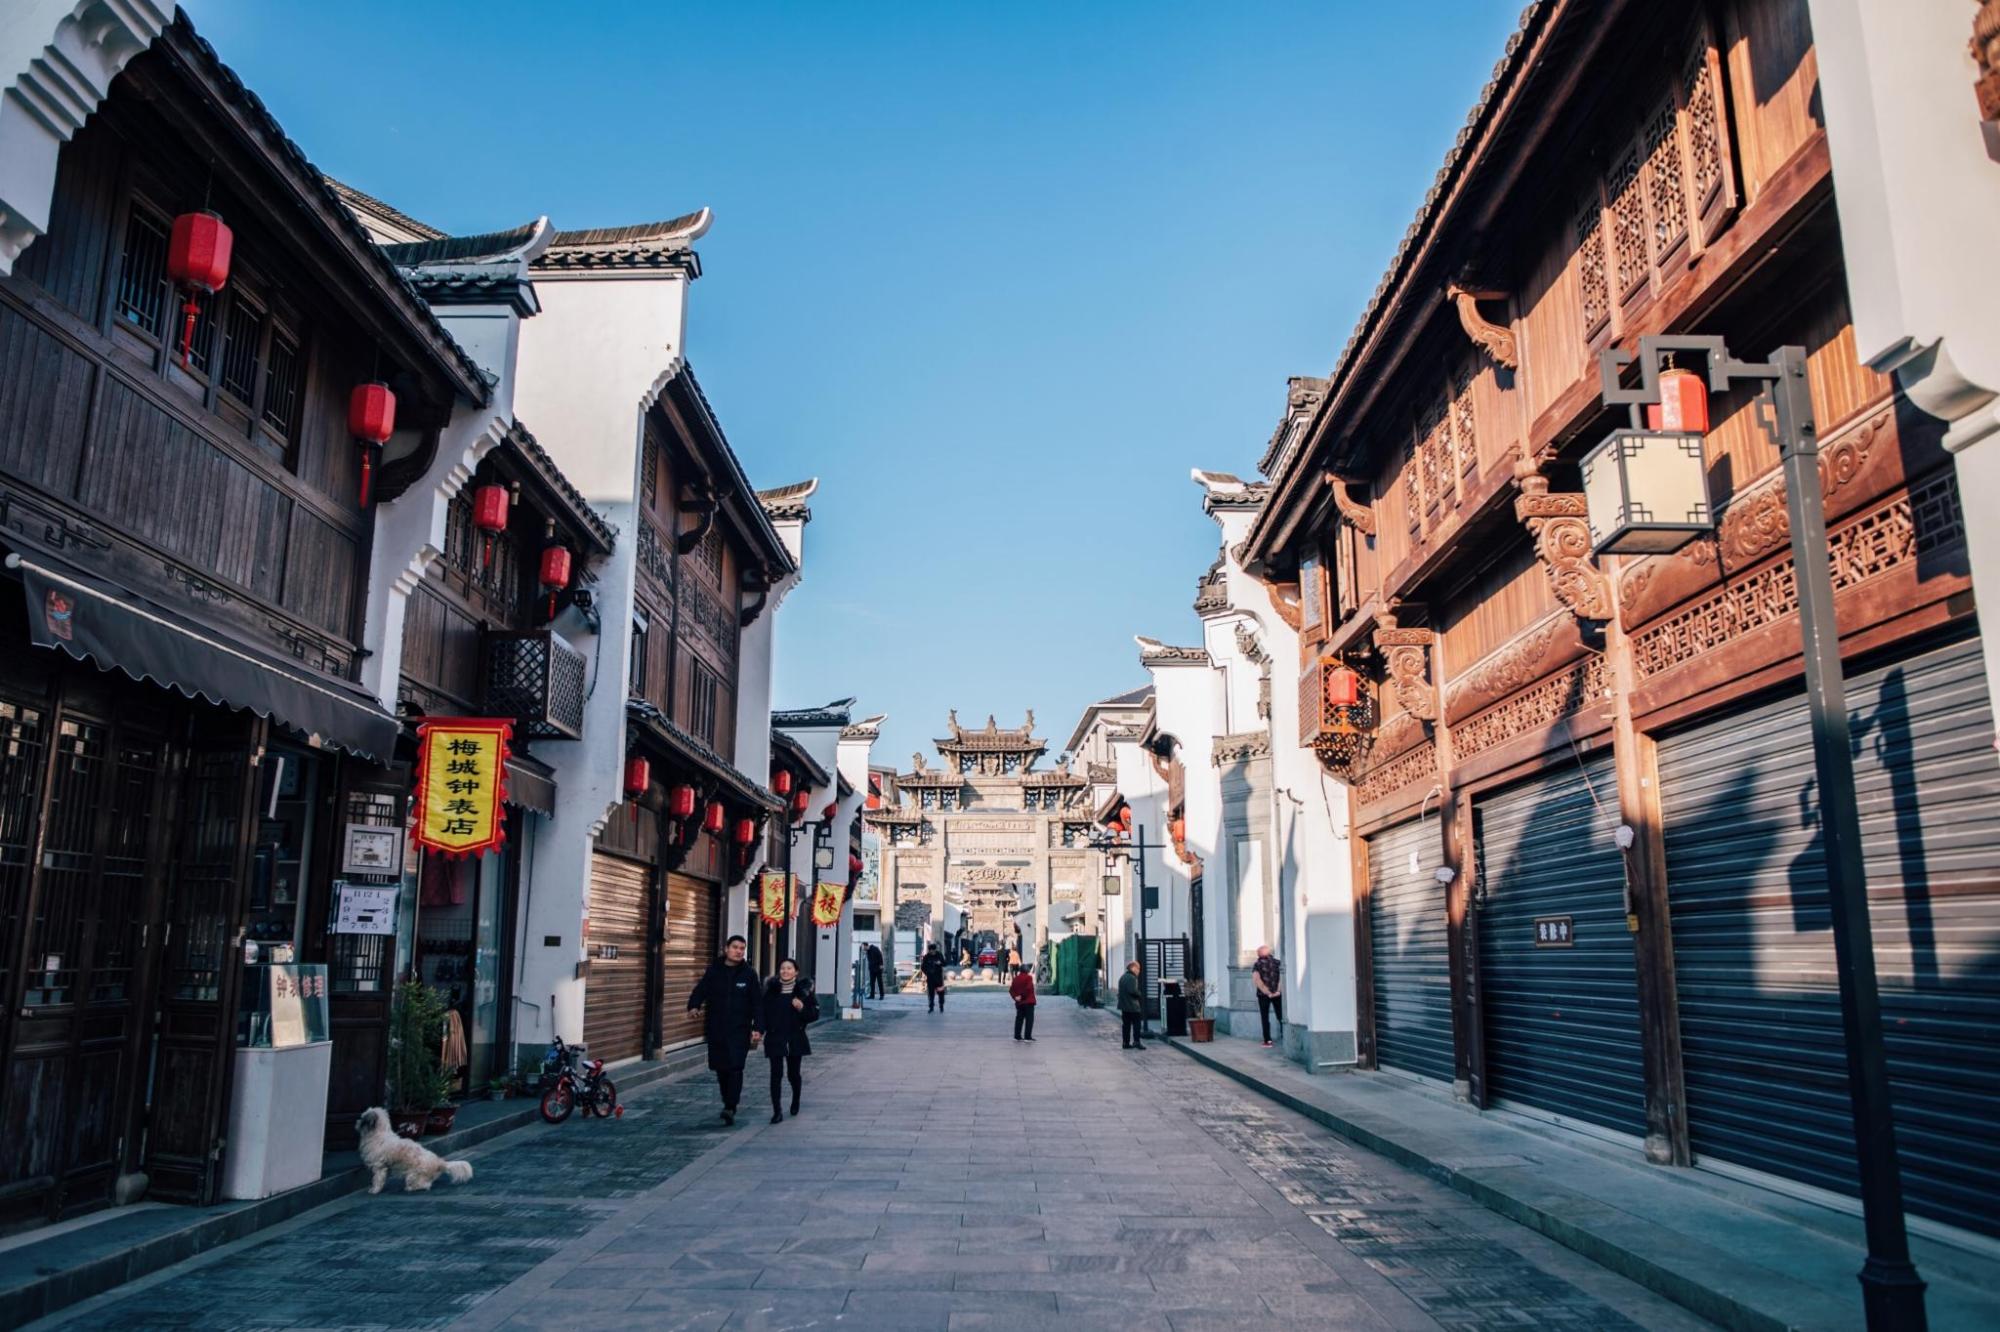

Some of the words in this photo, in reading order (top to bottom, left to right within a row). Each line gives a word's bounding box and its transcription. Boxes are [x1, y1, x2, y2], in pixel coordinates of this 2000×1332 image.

[440, 738, 483, 836] 梅城钟表店
[363, 890, 373, 898] 12
[275, 974, 325, 998] 钟表修理
